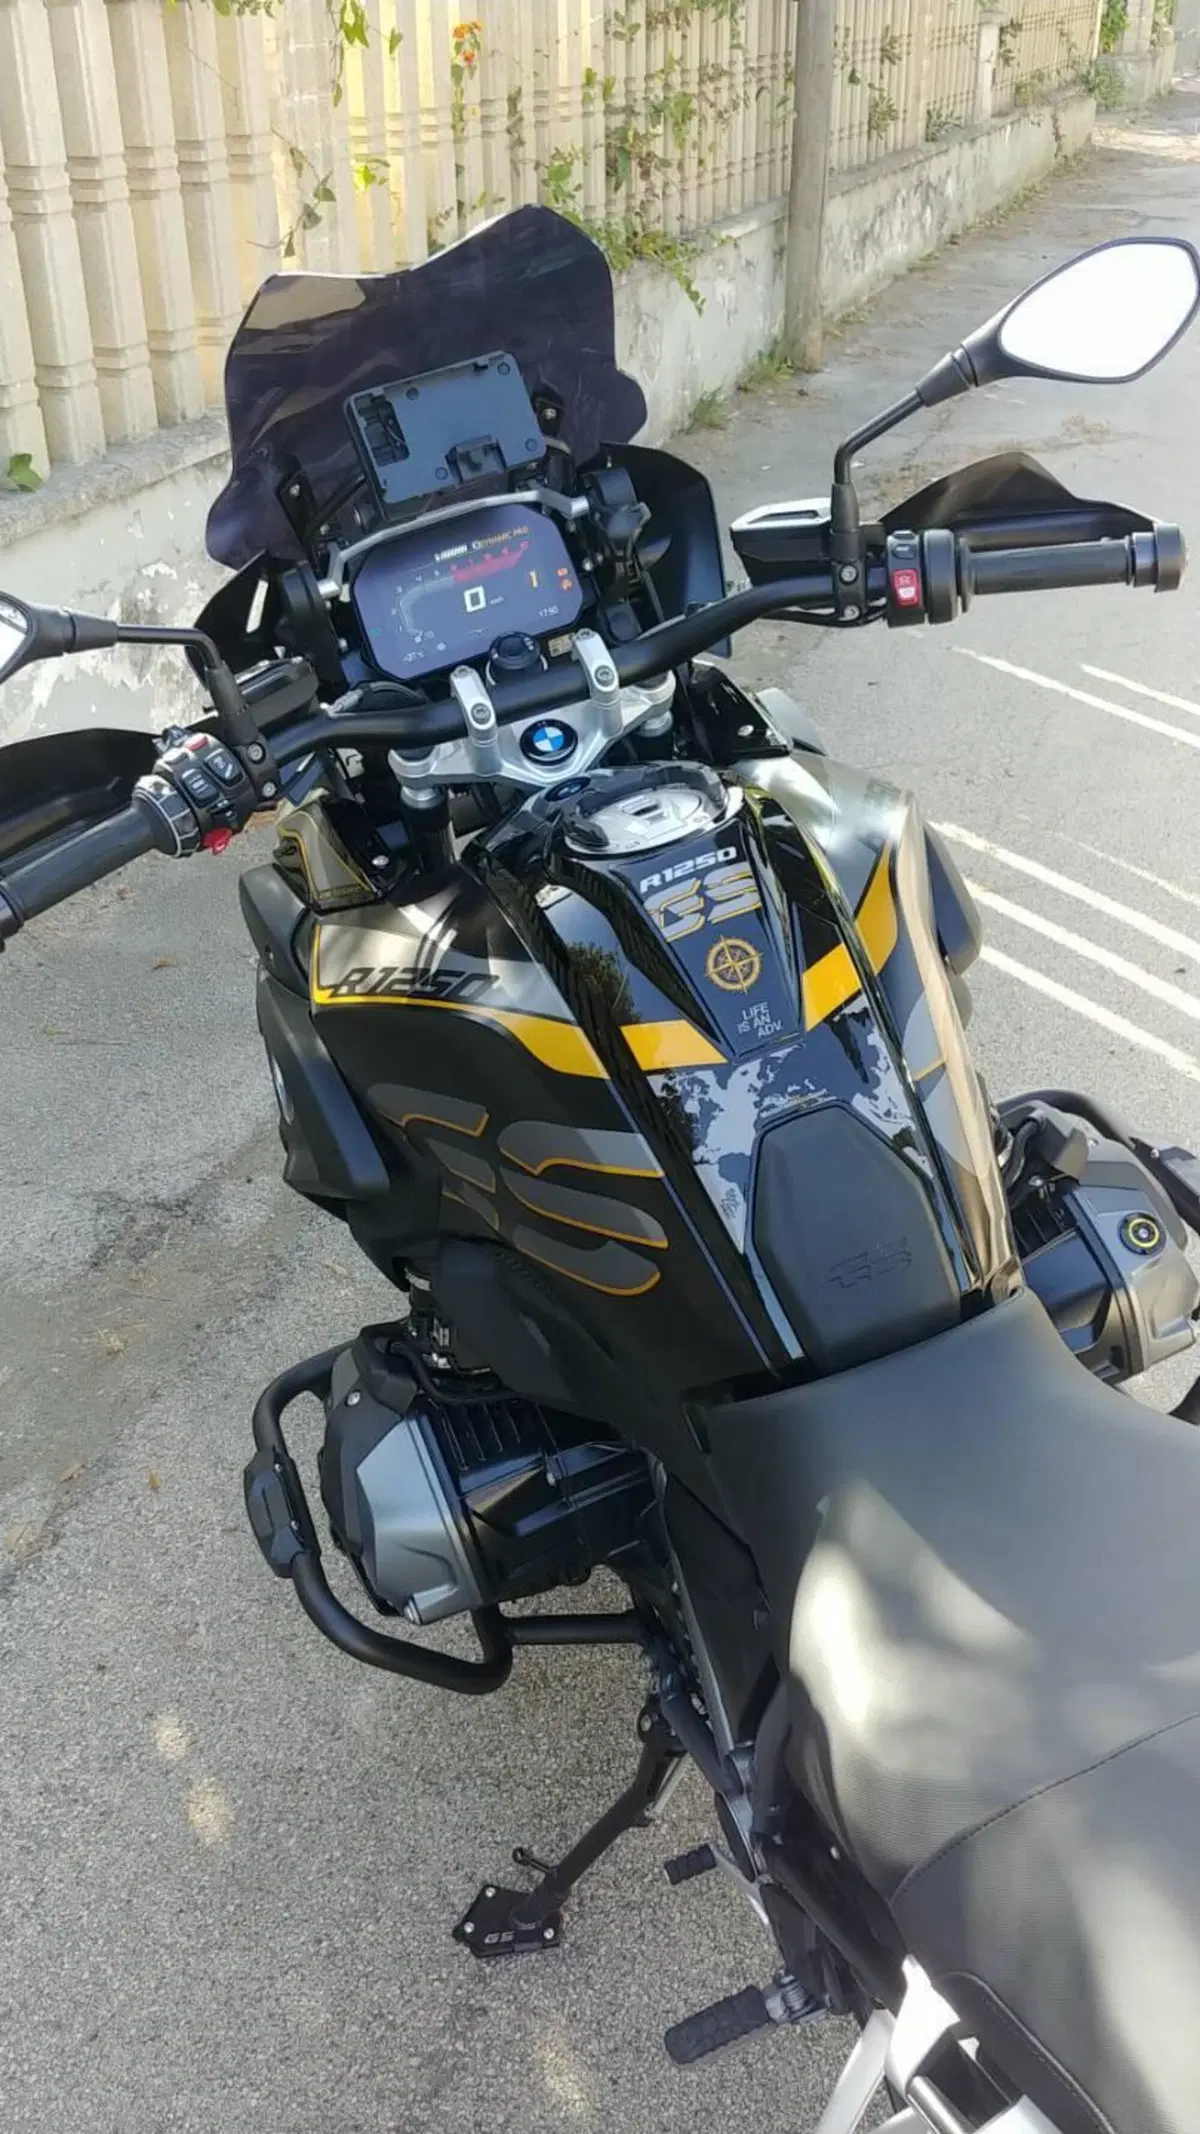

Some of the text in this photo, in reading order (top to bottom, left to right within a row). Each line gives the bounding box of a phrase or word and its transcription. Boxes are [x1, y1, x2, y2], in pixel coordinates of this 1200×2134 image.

[464, 585, 486, 613] 0
[639, 846, 738, 894] R1250
[643, 860, 762, 942] GS
[328, 966, 501, 1001] R1250
[738, 1012, 771, 1034] IS AN
[742, 1001, 769, 1021] LIFE
[484, 1931, 516, 1944] GS
